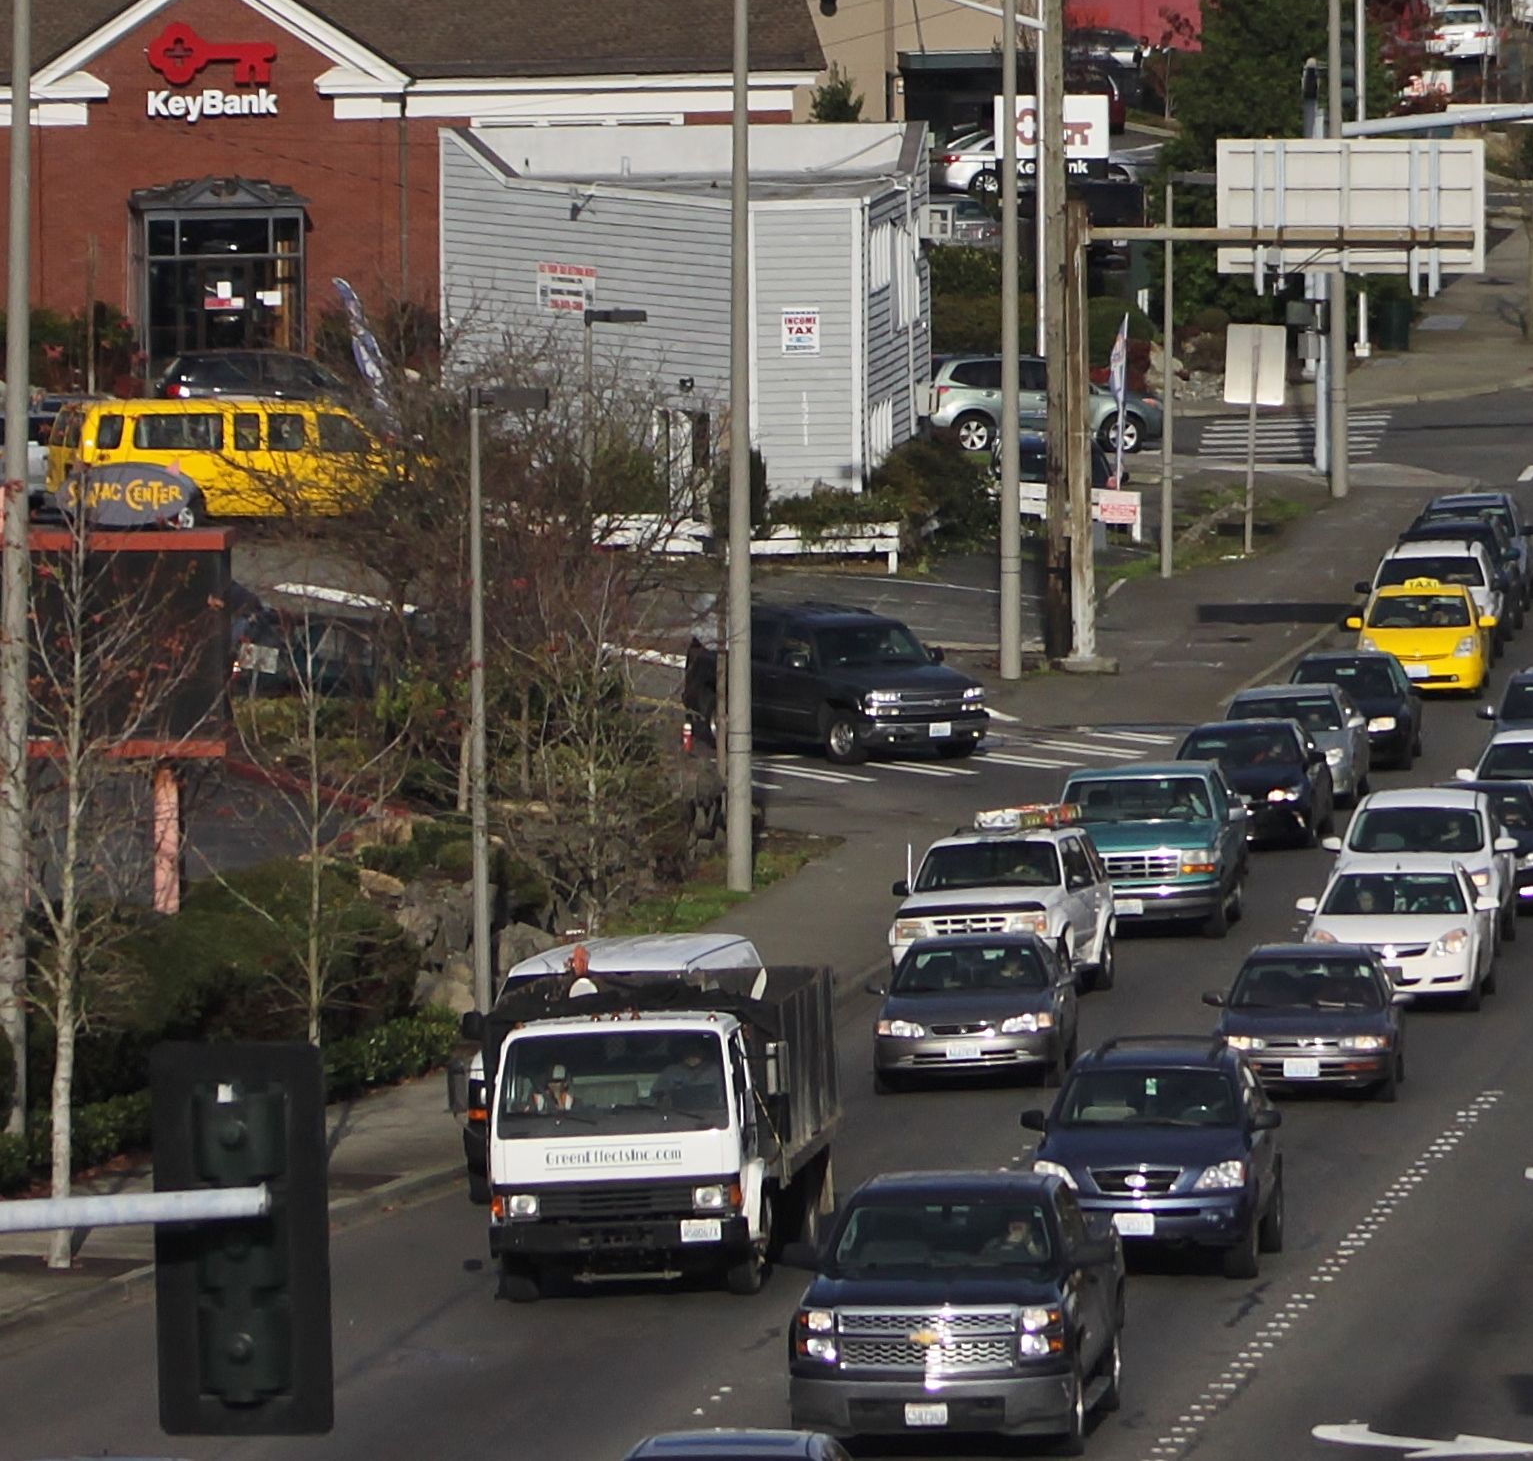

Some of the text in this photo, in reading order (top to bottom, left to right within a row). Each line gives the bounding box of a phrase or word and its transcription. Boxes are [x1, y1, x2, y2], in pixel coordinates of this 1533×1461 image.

[147, 88, 278, 122] KeyBank
[1016, 160, 1089, 174] Kenk
[787, 326, 814, 335] TAX
[1410, 580, 1437, 588] TAXI
